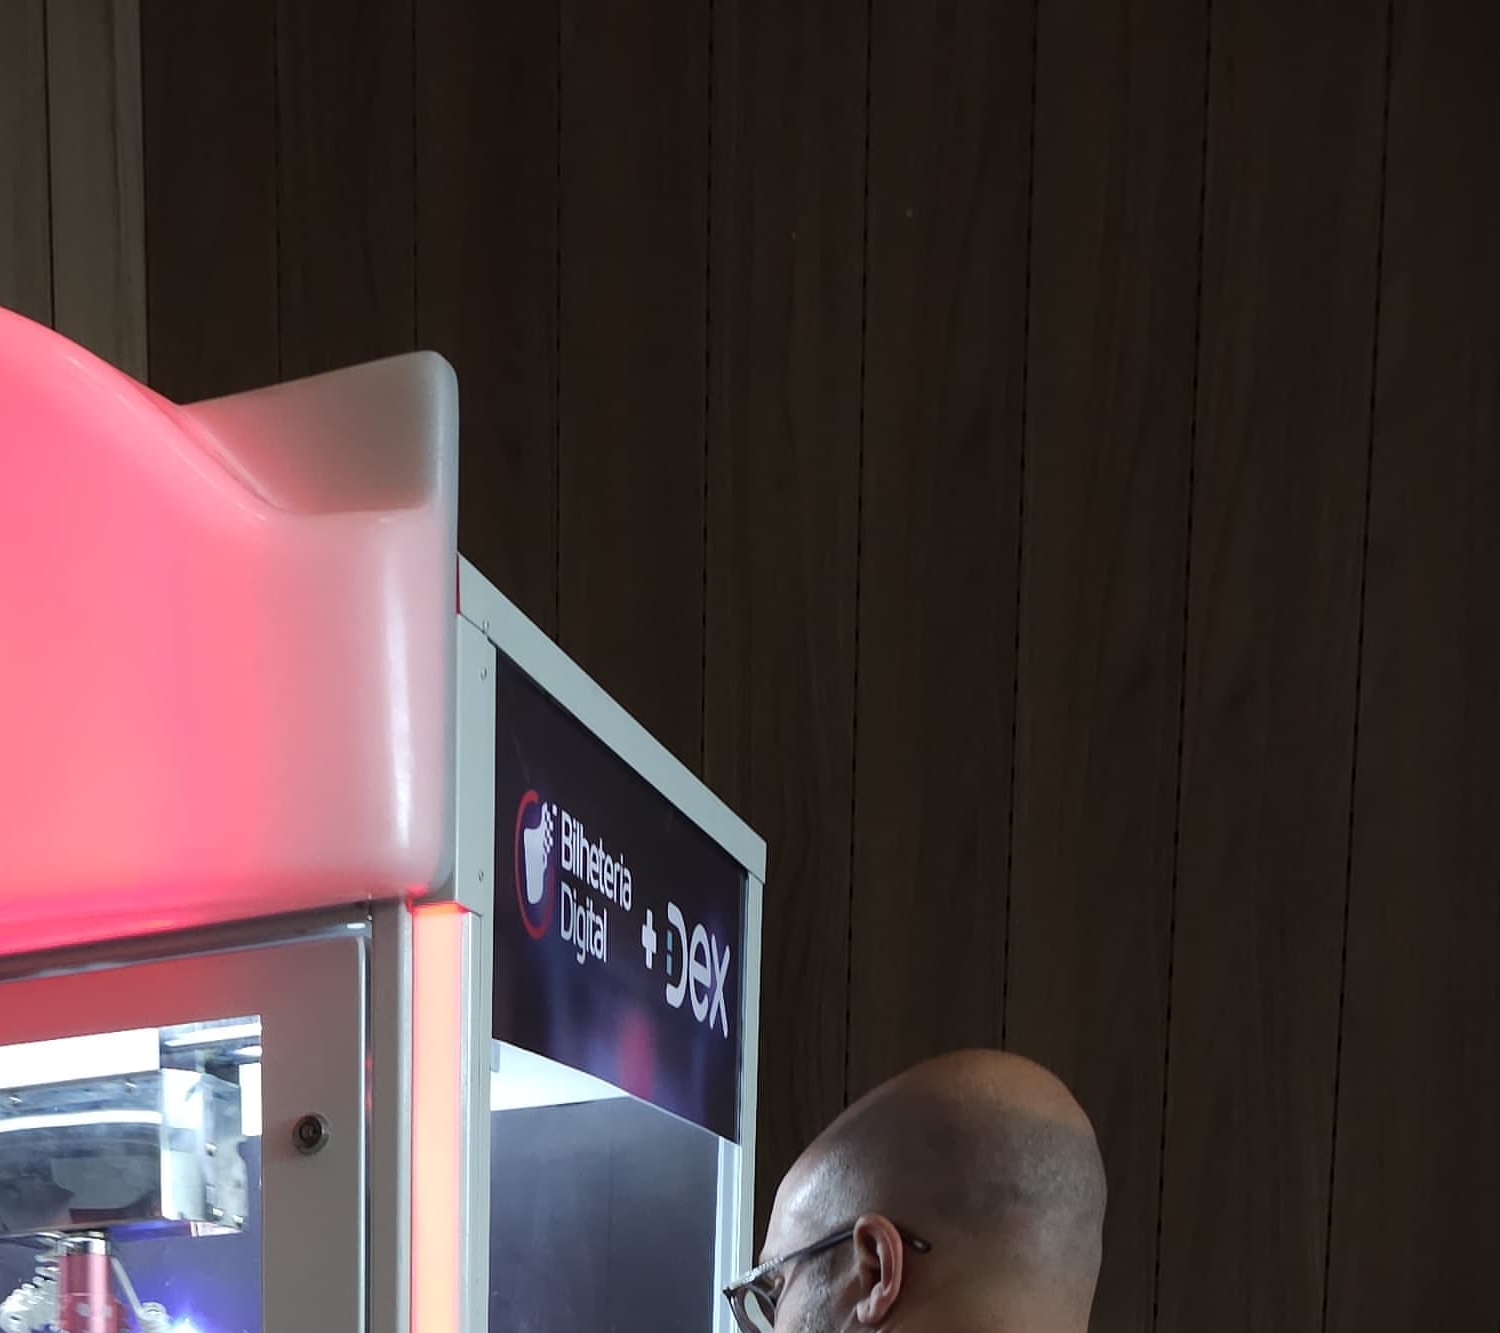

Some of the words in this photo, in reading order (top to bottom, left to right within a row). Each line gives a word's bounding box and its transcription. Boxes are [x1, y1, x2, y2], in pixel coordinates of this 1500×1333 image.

[560, 809, 633, 912] Bilheteria
[559, 884, 608, 966] Digital
[665, 901, 731, 1039] Dex
